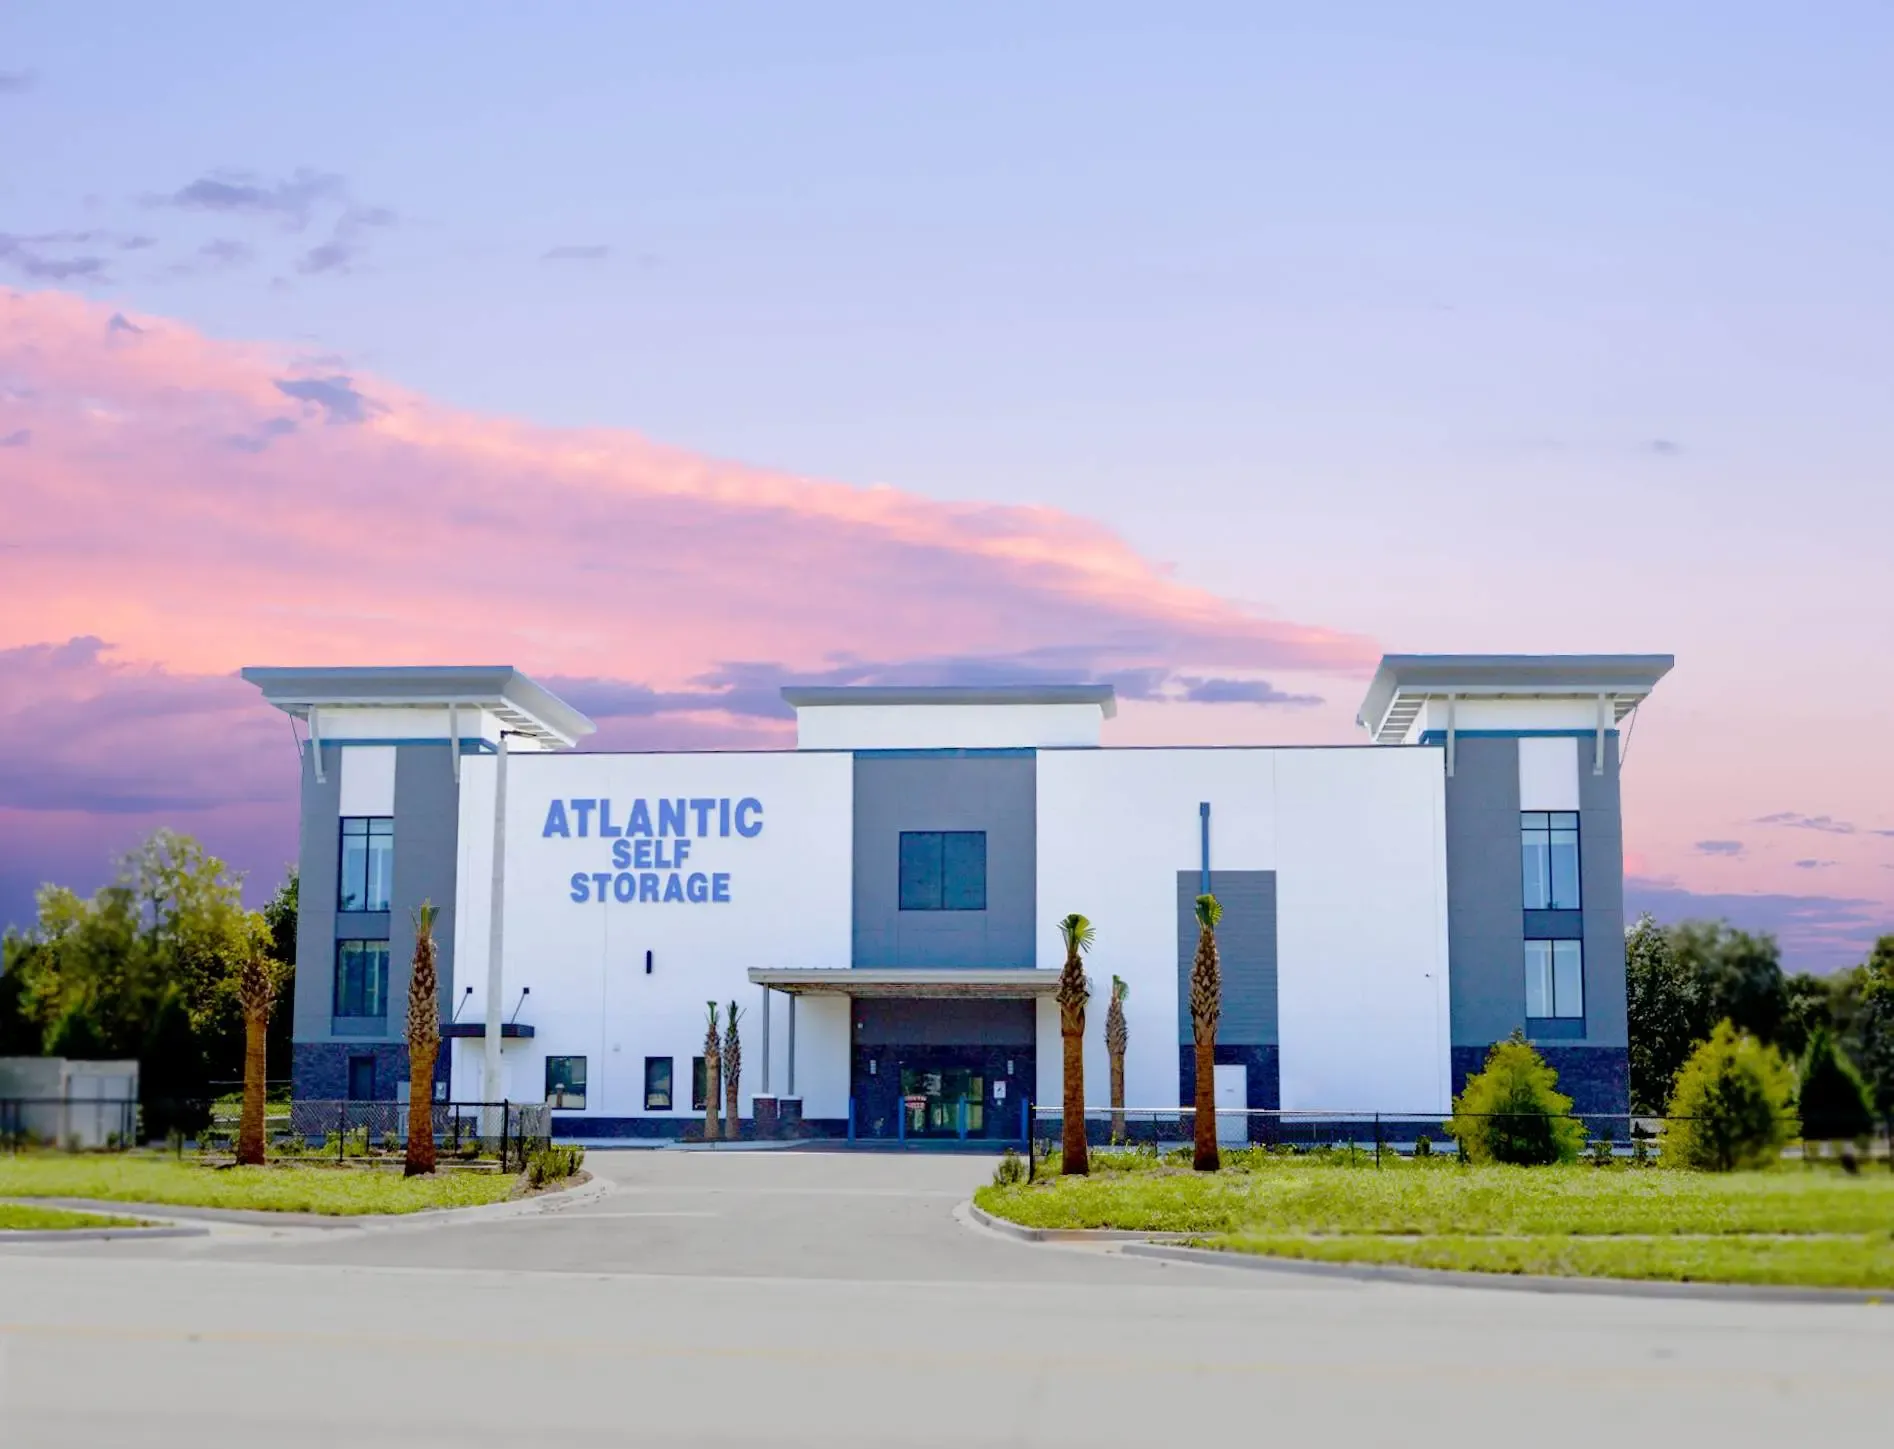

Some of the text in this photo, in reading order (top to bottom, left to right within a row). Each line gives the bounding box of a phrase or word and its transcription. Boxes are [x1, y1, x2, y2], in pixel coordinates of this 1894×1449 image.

[542, 797, 763, 838] ATLANTIC
[612, 838, 691, 869] SELF
[570, 872, 731, 903] STORAGE
